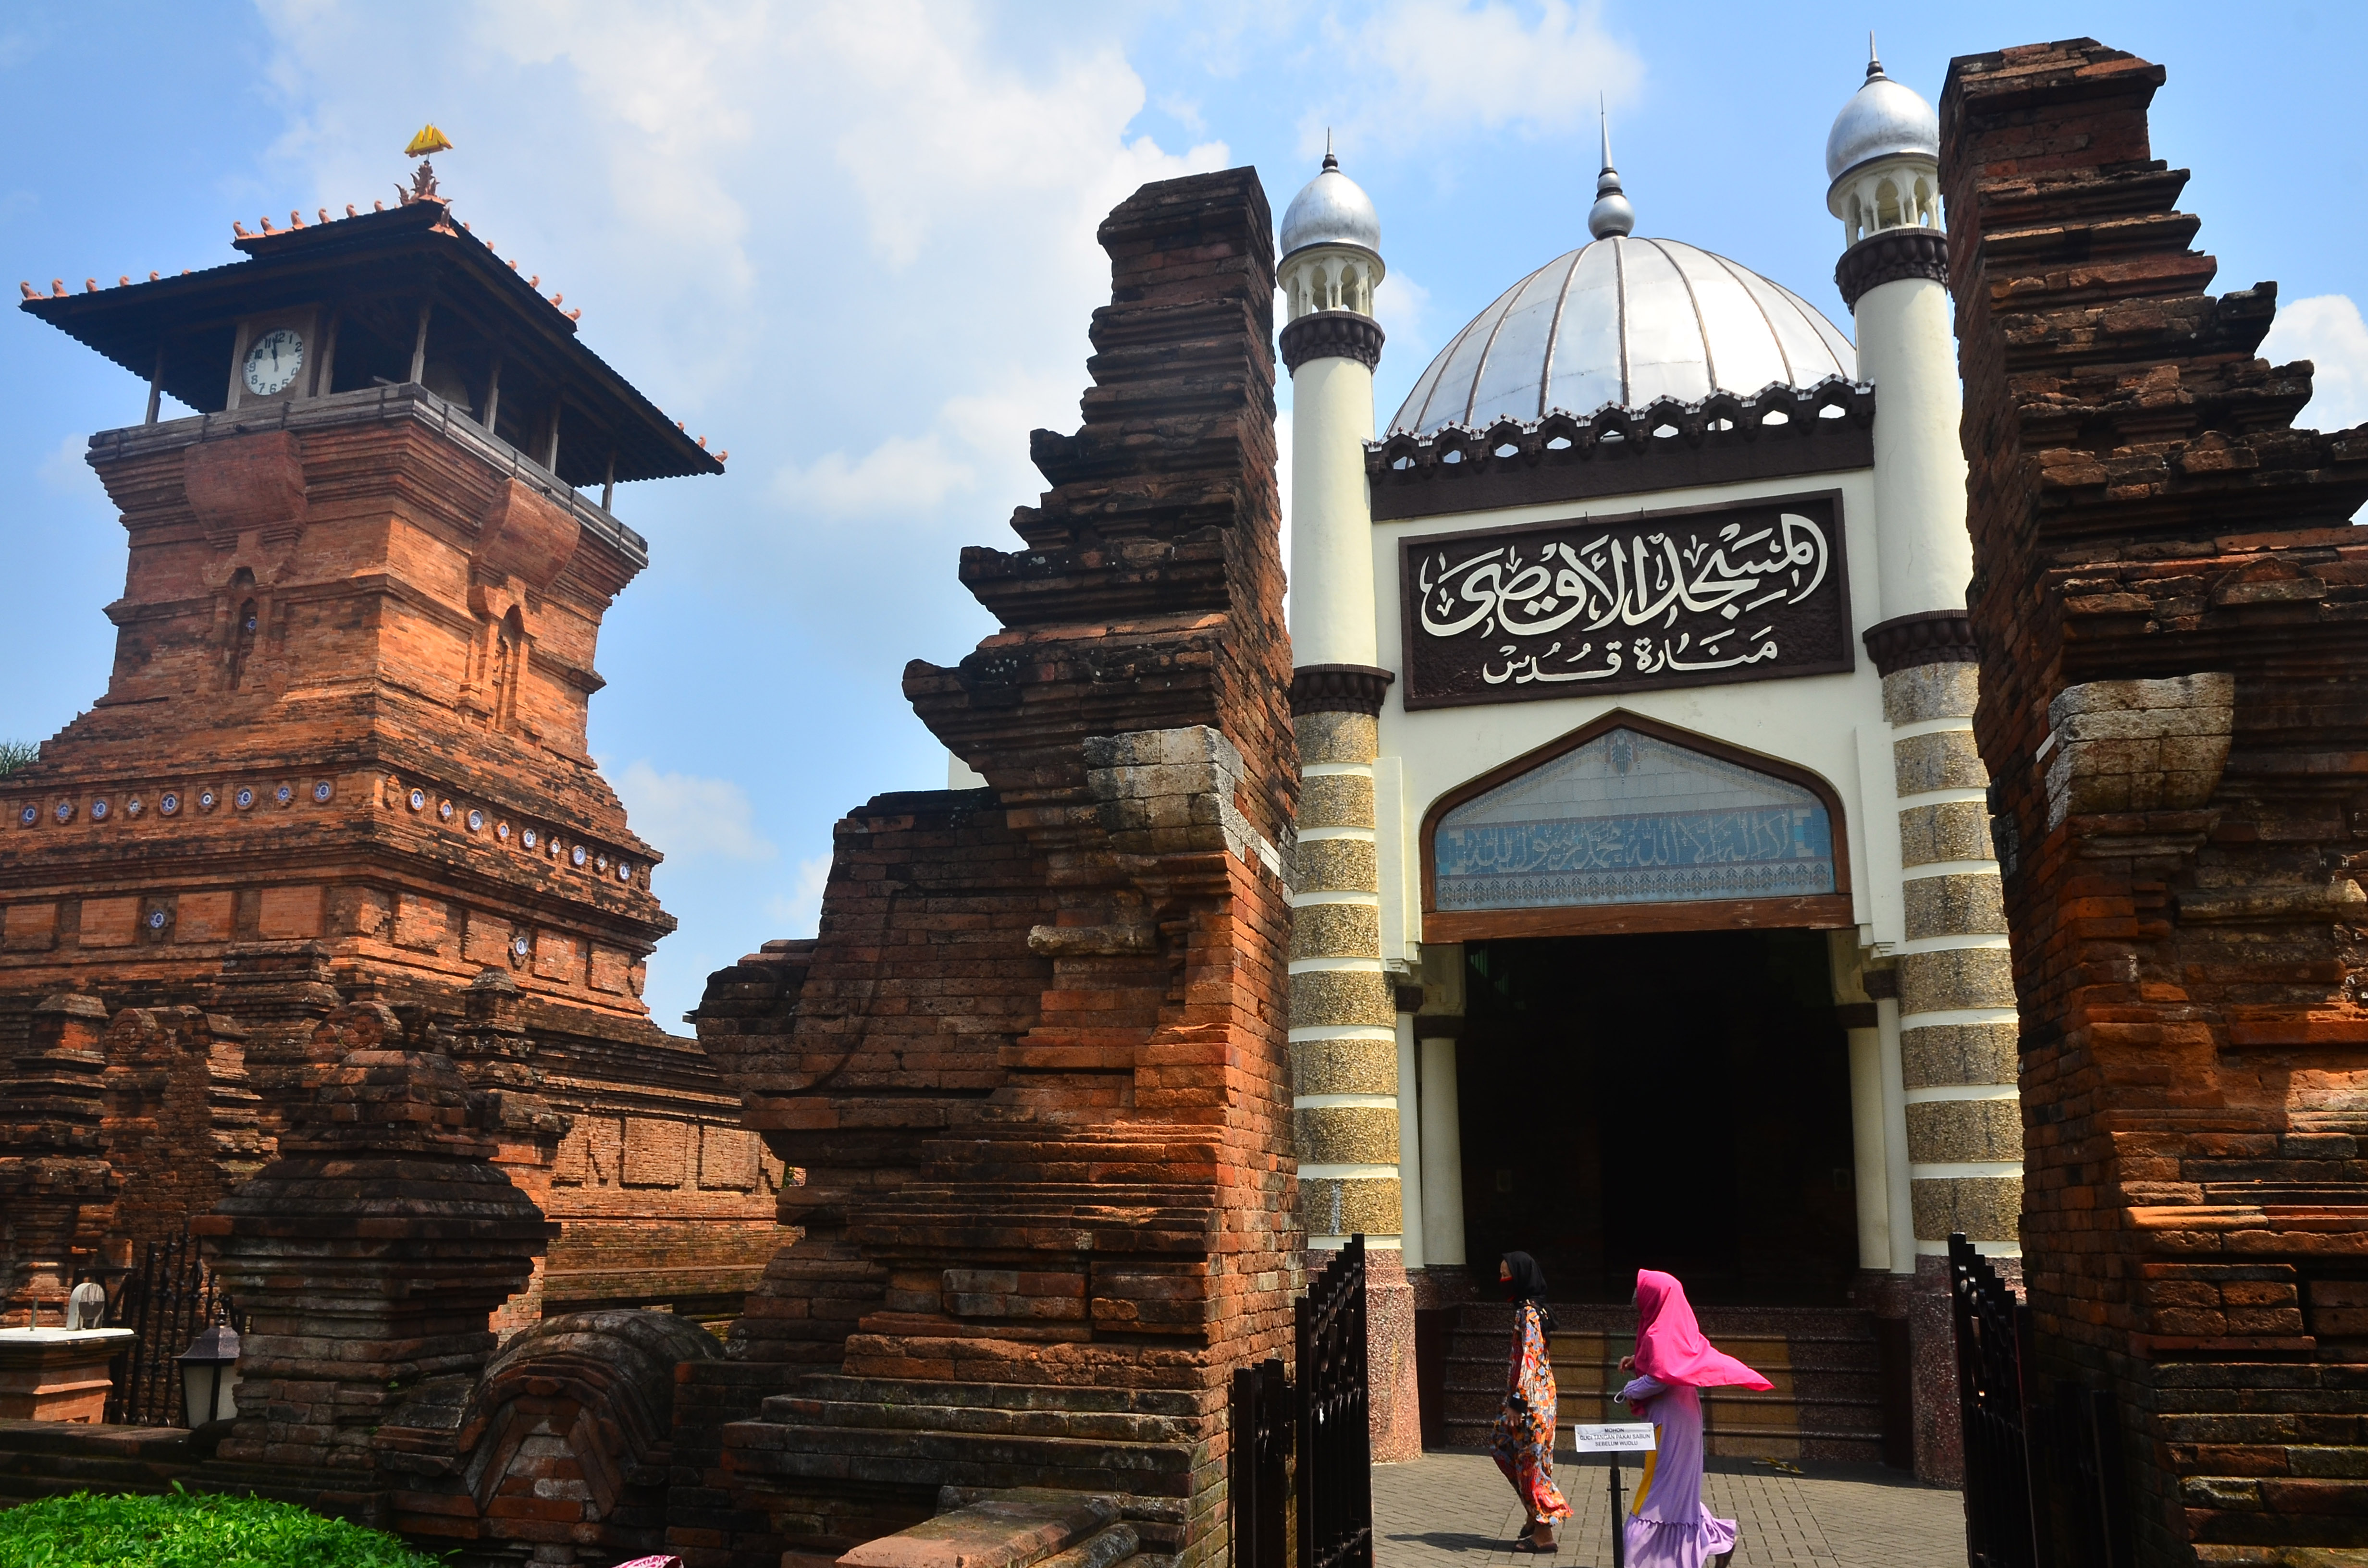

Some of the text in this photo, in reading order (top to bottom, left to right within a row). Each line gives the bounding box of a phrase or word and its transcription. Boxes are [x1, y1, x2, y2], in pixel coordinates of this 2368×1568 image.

[264, 338, 271, 349] 11
[274, 332, 285, 344] 12
[289, 333, 293, 344] 1
[295, 342, 302, 353] 2
[254, 349, 263, 360] 10
[248, 362, 256, 372] 9
[251, 375, 258, 385] 8
[259, 382, 266, 393] 7
[269, 383, 277, 393] 6
